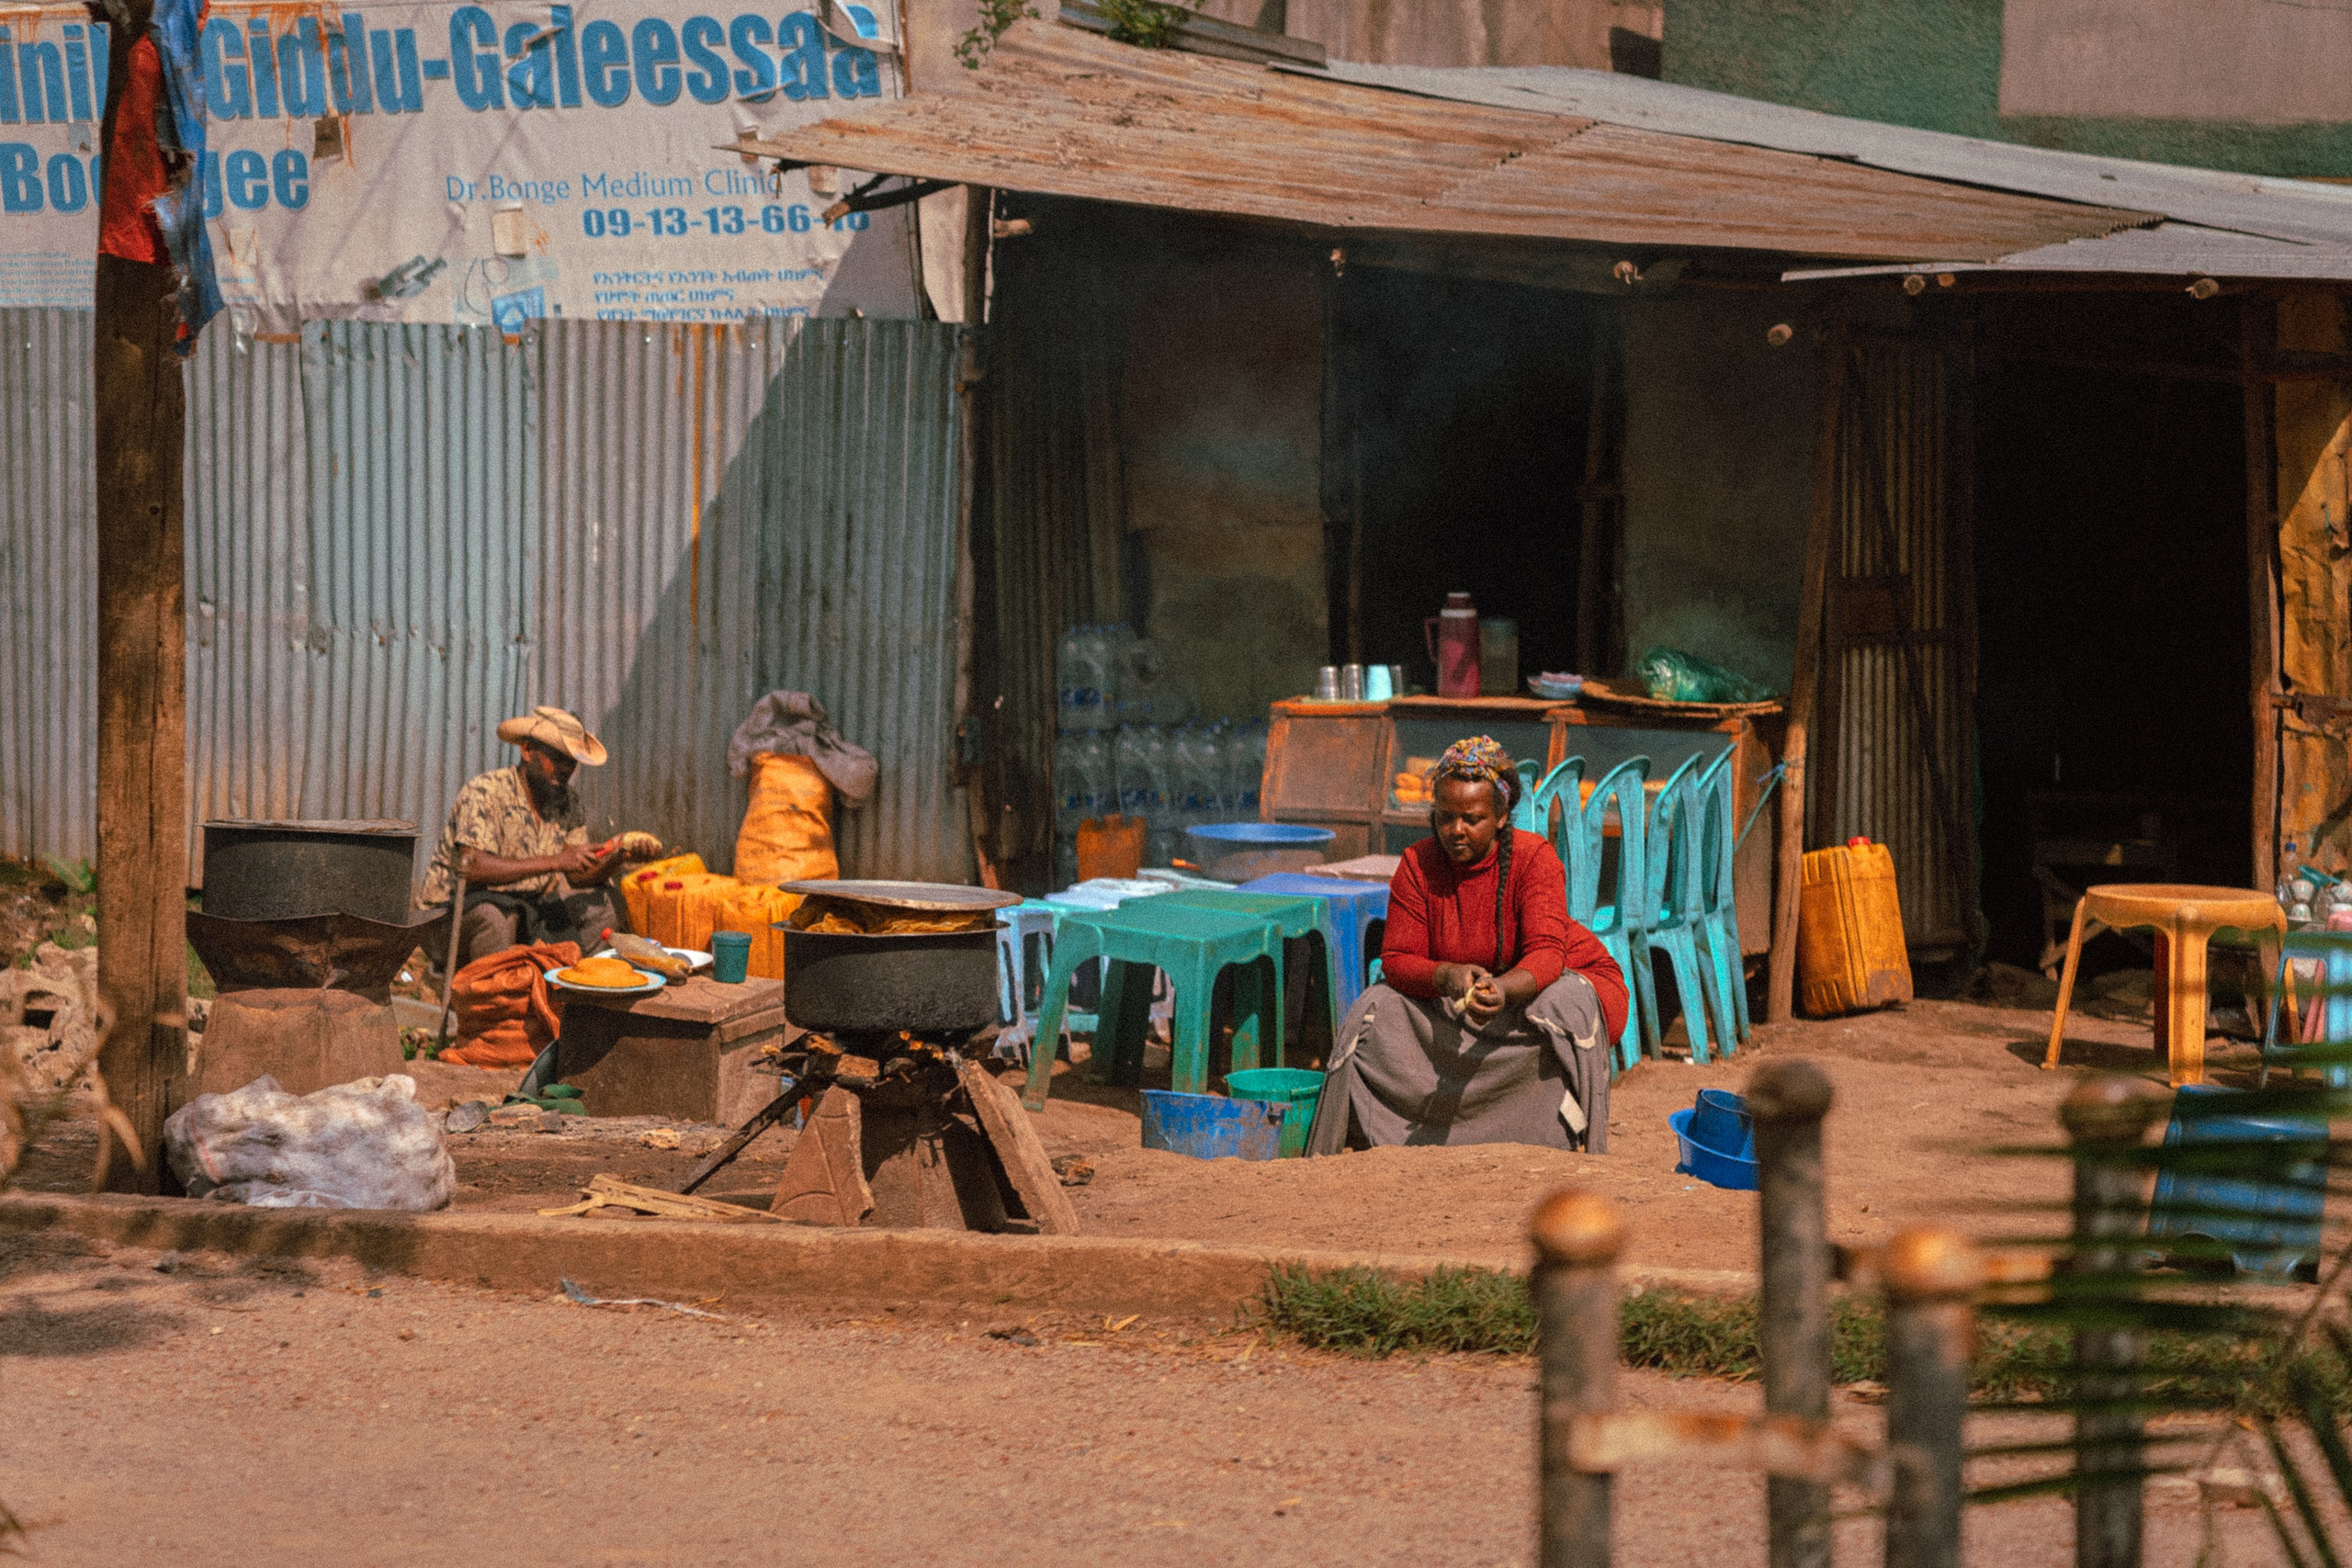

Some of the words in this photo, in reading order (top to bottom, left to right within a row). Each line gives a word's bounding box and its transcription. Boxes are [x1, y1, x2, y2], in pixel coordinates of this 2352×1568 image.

[200, 4, 882, 121] Giddu-Galeessaa
[446, 175, 571, 205] Dr.Bonge
[581, 172, 693, 198] Medium
[705, 169, 783, 197] Clinic
